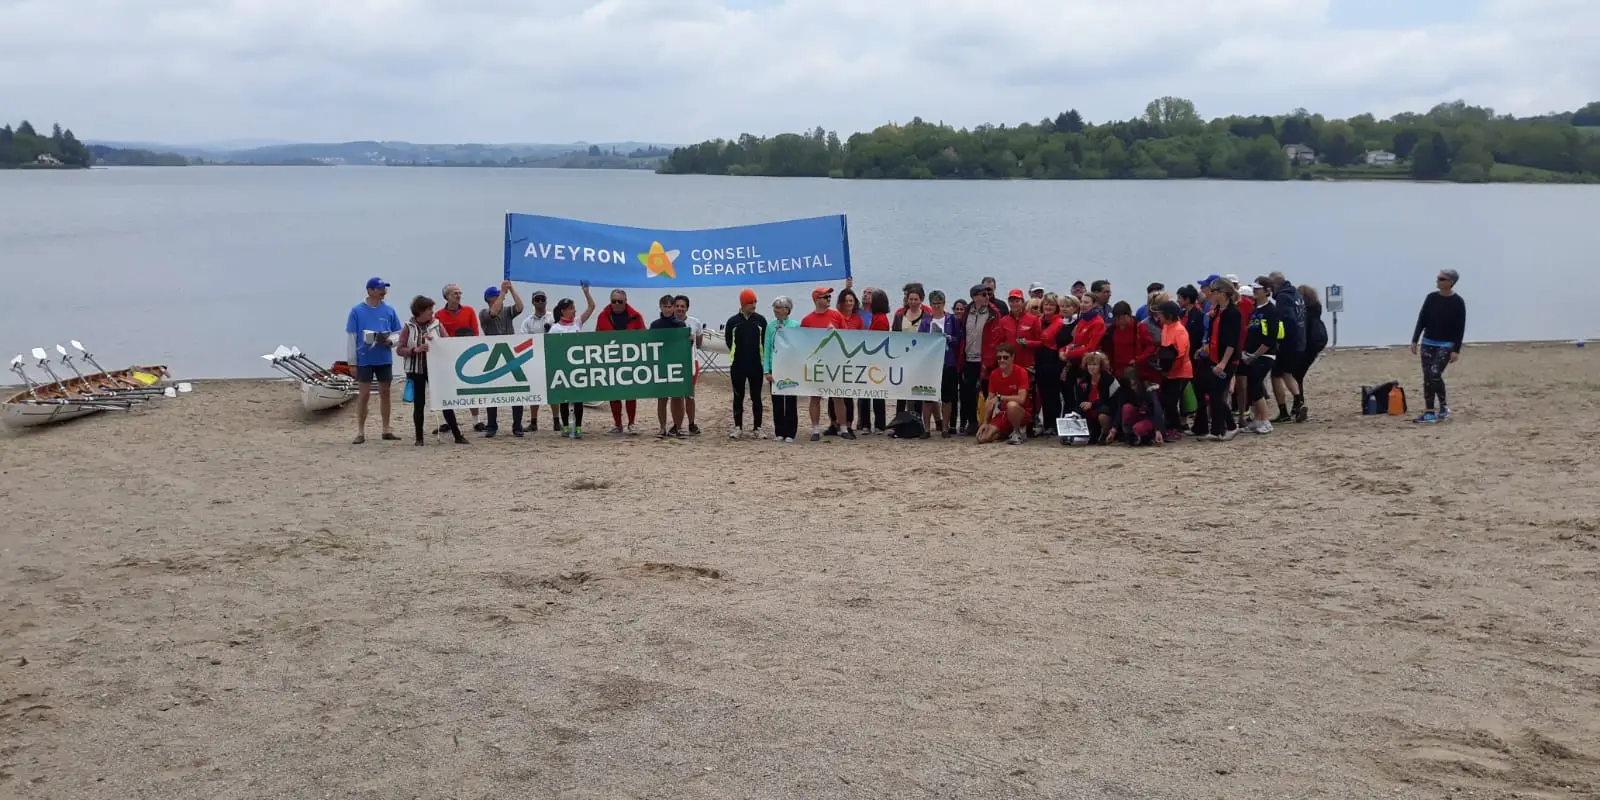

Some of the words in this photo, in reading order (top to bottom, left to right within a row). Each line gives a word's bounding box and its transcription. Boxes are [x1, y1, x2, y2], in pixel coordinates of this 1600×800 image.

[524, 242, 626, 264] AVEYRON
[691, 246, 761, 261] CONSEIL
[692, 254, 832, 276] DÉPARTEMENTAL
[566, 340, 664, 365] CRÉDIT
[550, 363, 684, 389] AGRICOLE
[804, 359, 904, 386] LÉVÉZOU
[442, 397, 475, 407] BANQUE
[478, 396, 487, 405] ET
[490, 394, 542, 404] ASSURANCES
[818, 387, 862, 396] SYNDICAT
[863, 389, 889, 398] MIXTE
